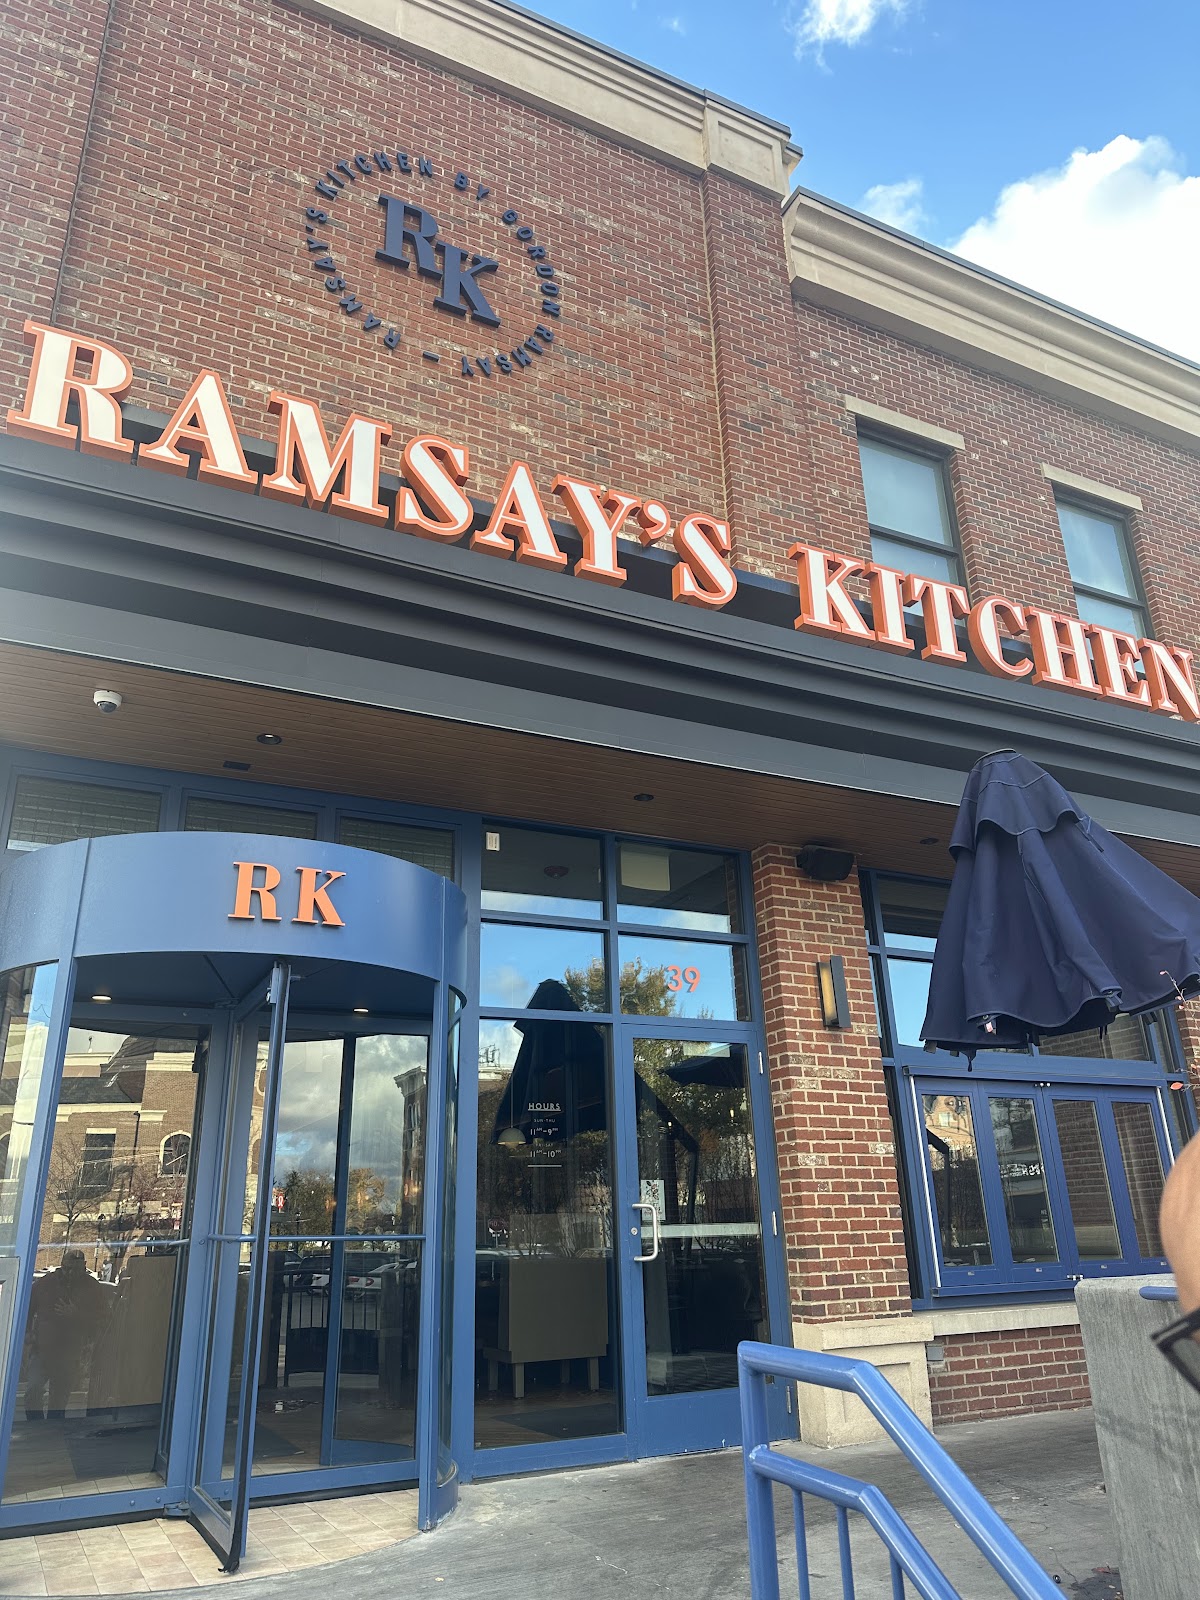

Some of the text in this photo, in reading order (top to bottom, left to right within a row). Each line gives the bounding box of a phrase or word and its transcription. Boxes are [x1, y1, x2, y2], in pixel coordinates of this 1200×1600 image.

[305, 151, 560, 378] RAMSAY'S KITCHEN BY GORDON RAMSAY
[375, 193, 500, 328] RK
[6, 320, 1200, 722] RAMSAY'S KITCHEN
[666, 965, 701, 993] 39
[528, 1102, 561, 1110] HOURS
